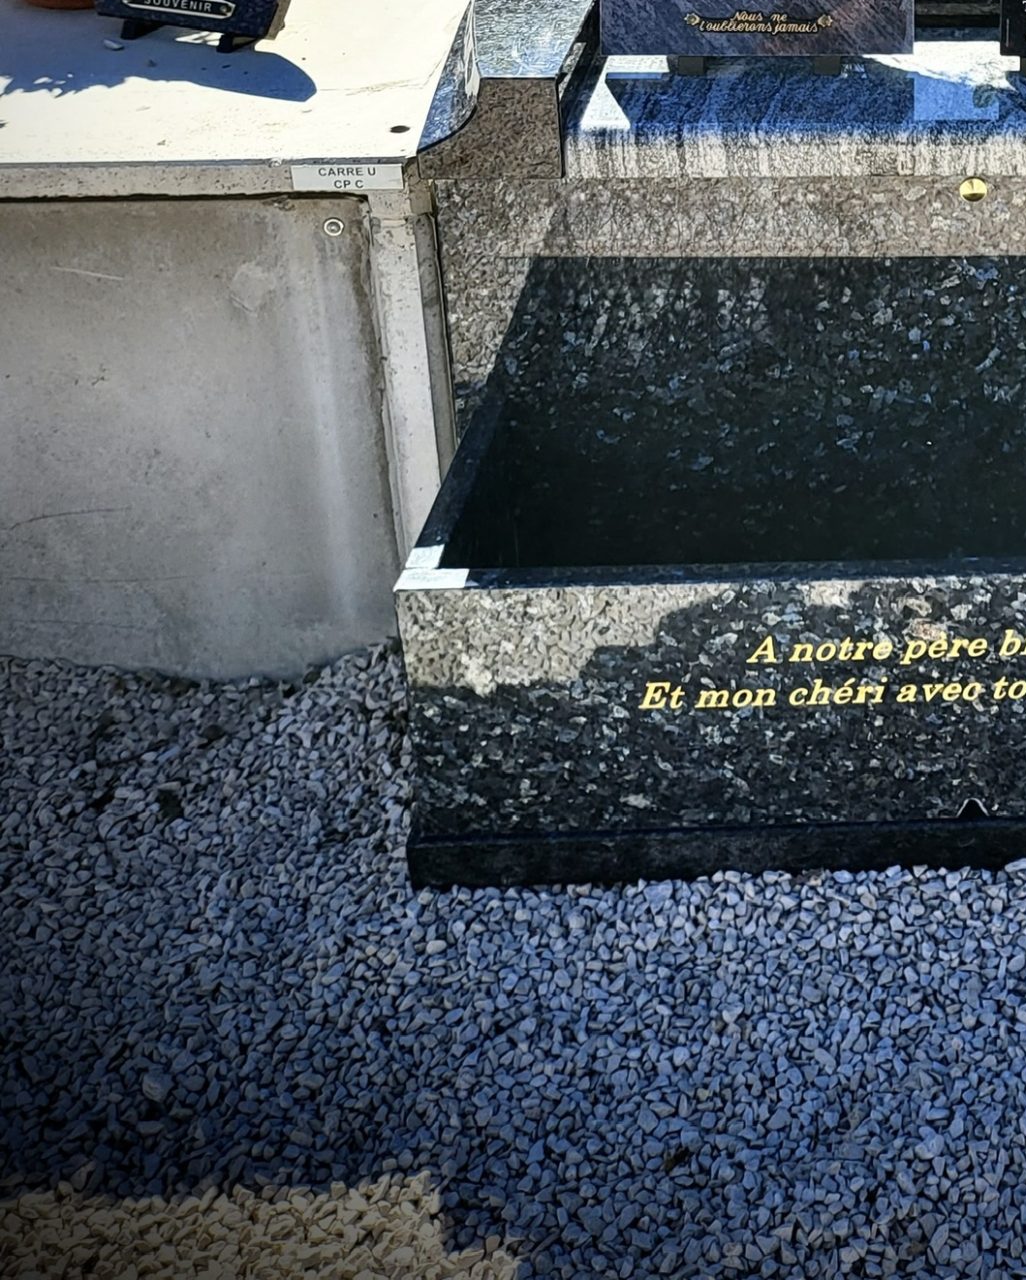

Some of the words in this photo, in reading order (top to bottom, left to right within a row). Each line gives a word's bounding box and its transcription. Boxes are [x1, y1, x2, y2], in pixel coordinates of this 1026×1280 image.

[730, 11, 763, 21] Nous
[771, 20, 819, 35] jamais
[318, 167, 364, 176] CARRE
[367, 167, 376, 176] U
[334, 180, 351, 189] CP
[355, 180, 364, 189] C
[746, 635, 777, 663] A
[788, 637, 893, 662] notre
[900, 631, 988, 665] père
[638, 682, 684, 709] Et
[694, 687, 777, 709] mon
[788, 677, 889, 706] chéri
[896, 681, 982, 703] avec
